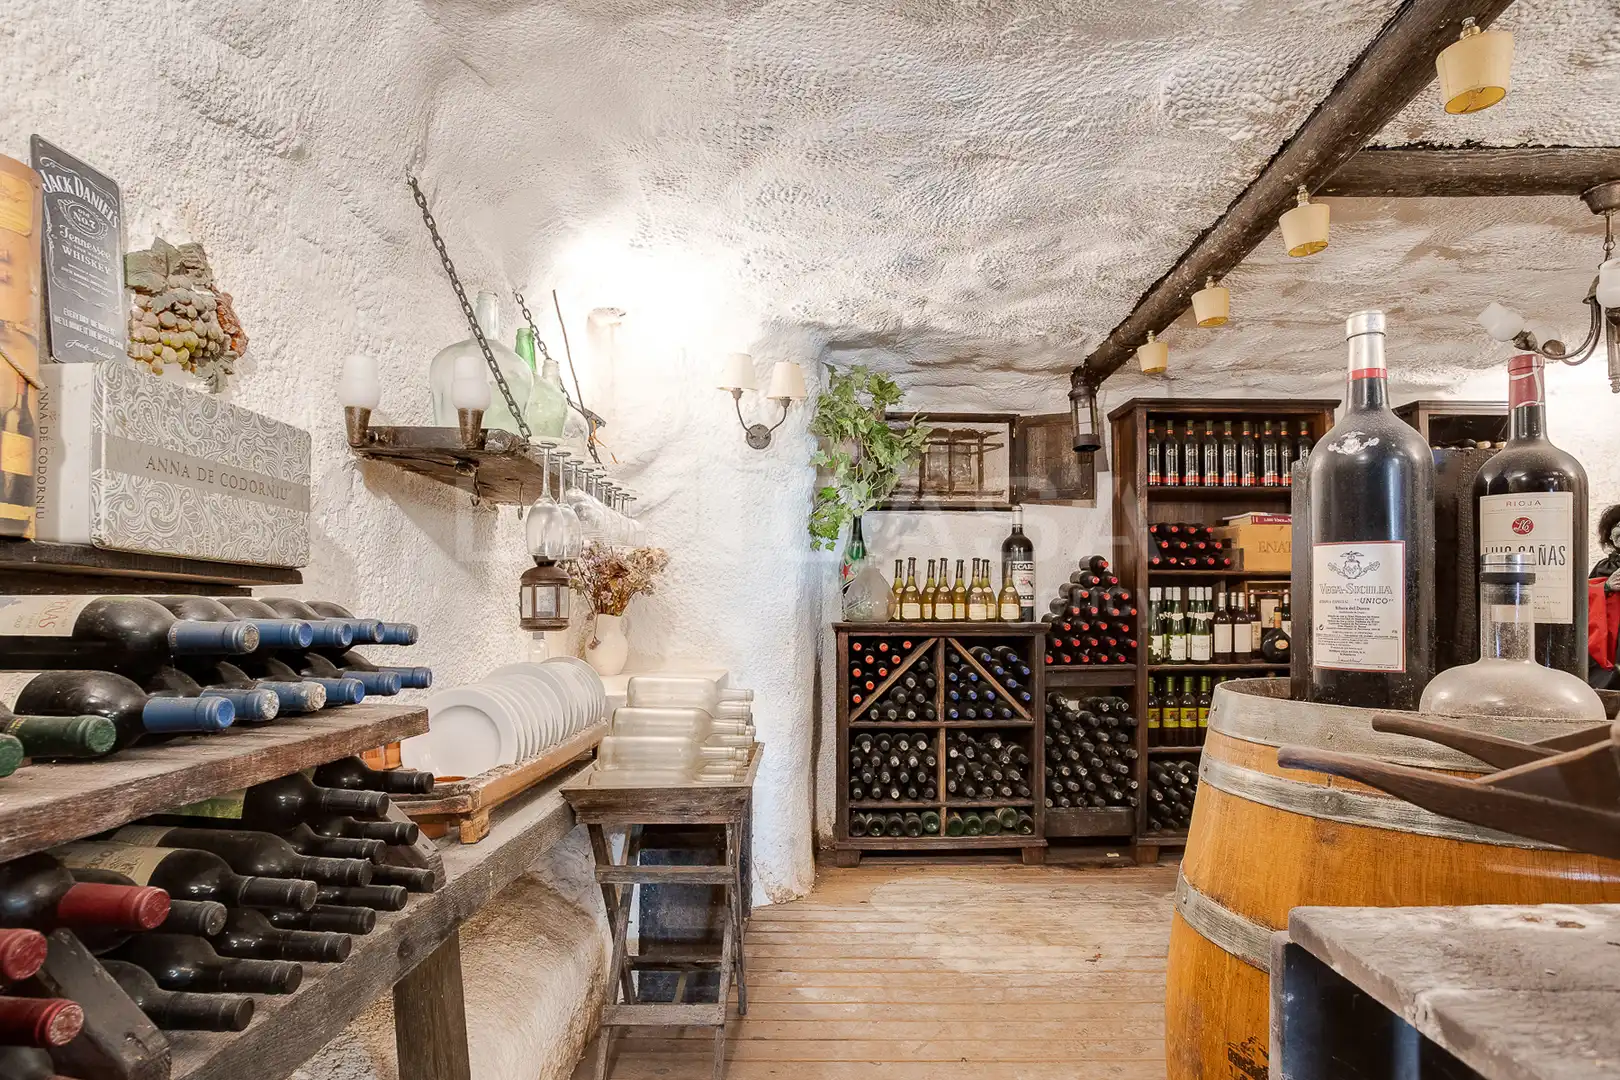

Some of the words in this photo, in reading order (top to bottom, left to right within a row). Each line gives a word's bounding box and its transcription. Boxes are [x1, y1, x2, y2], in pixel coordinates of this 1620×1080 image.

[40, 169, 75, 195] JACK
[74, 175, 120, 229] DANIEL'S
[59, 224, 111, 260] Tennessee
[61, 244, 111, 274] WHISKEY
[39, 385, 49, 423] NNA
[145, 455, 190, 478] ANNA
[197, 467, 214, 484] DE
